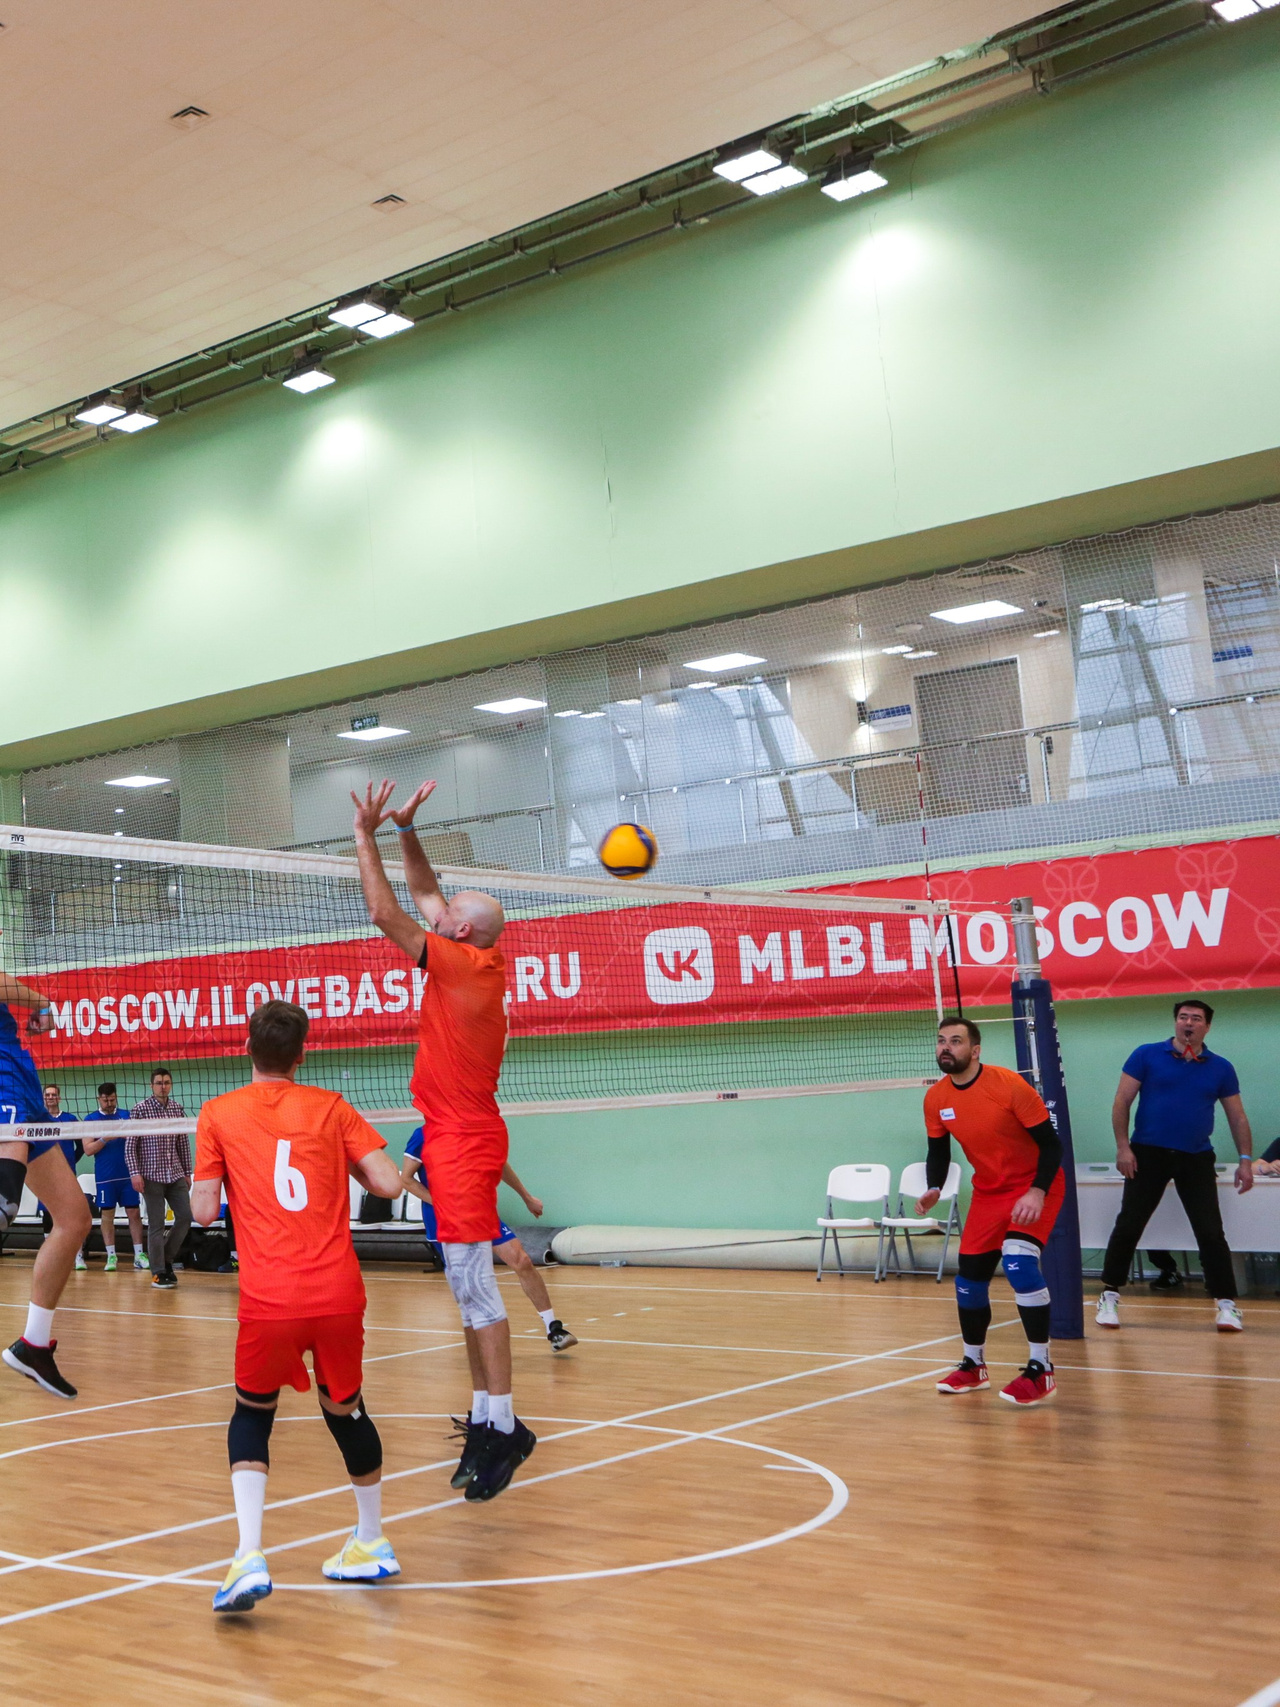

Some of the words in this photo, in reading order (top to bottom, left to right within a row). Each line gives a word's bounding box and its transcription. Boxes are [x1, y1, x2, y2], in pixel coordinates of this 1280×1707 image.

[737, 887, 1230, 985] MLBLMOSCOW
[1, 1105, 17, 1124] 7
[273, 1139, 308, 1212] 6
